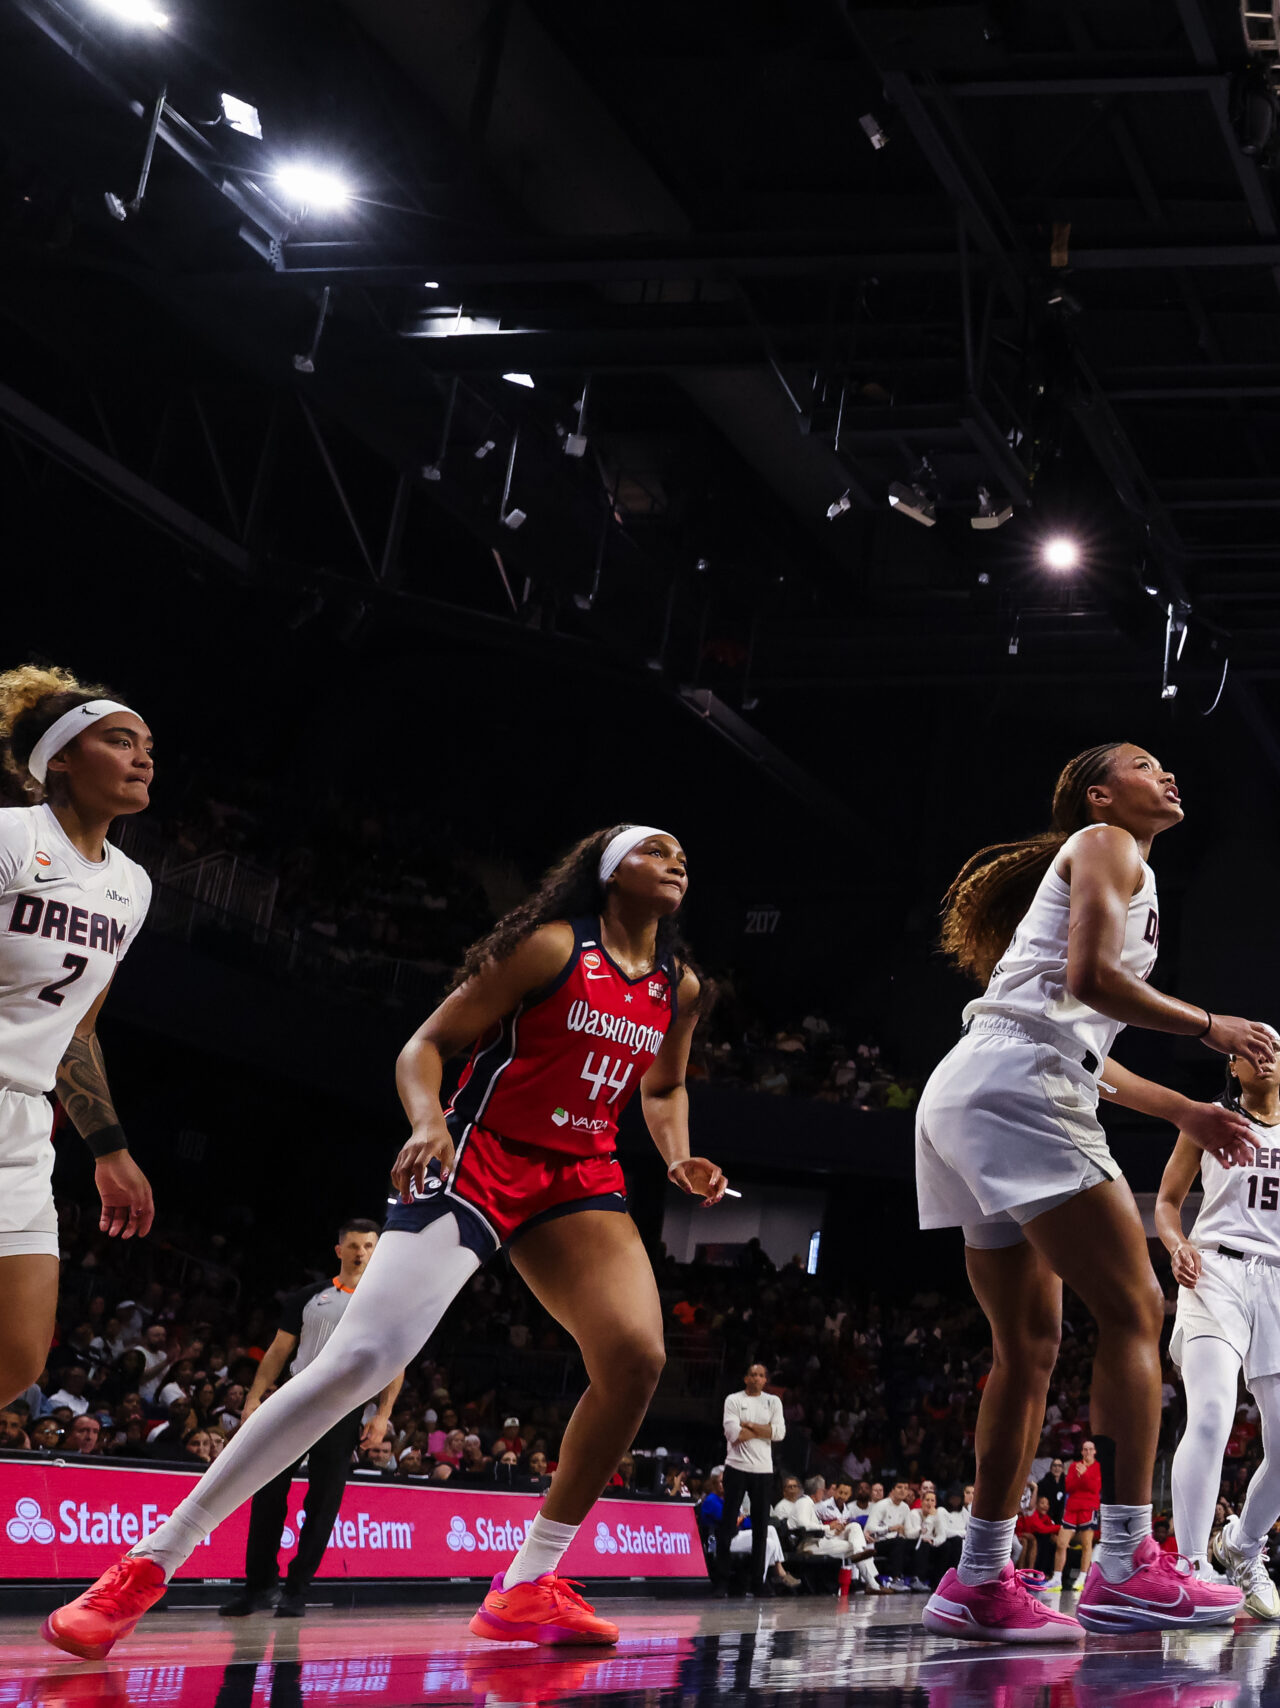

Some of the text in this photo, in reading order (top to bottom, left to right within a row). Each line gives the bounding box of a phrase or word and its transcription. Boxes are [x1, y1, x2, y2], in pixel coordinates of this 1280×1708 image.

[105, 888, 130, 907] Albert
[8, 893, 127, 956] DREAM
[744, 910, 781, 934] 207
[37, 952, 89, 1007] 2
[566, 999, 664, 1057] Washington
[580, 1051, 634, 1105] 44
[1247, 1174, 1280, 1211] 15
[59, 1500, 211, 1546] StateF
[616, 1523, 691, 1554] StateFarm
